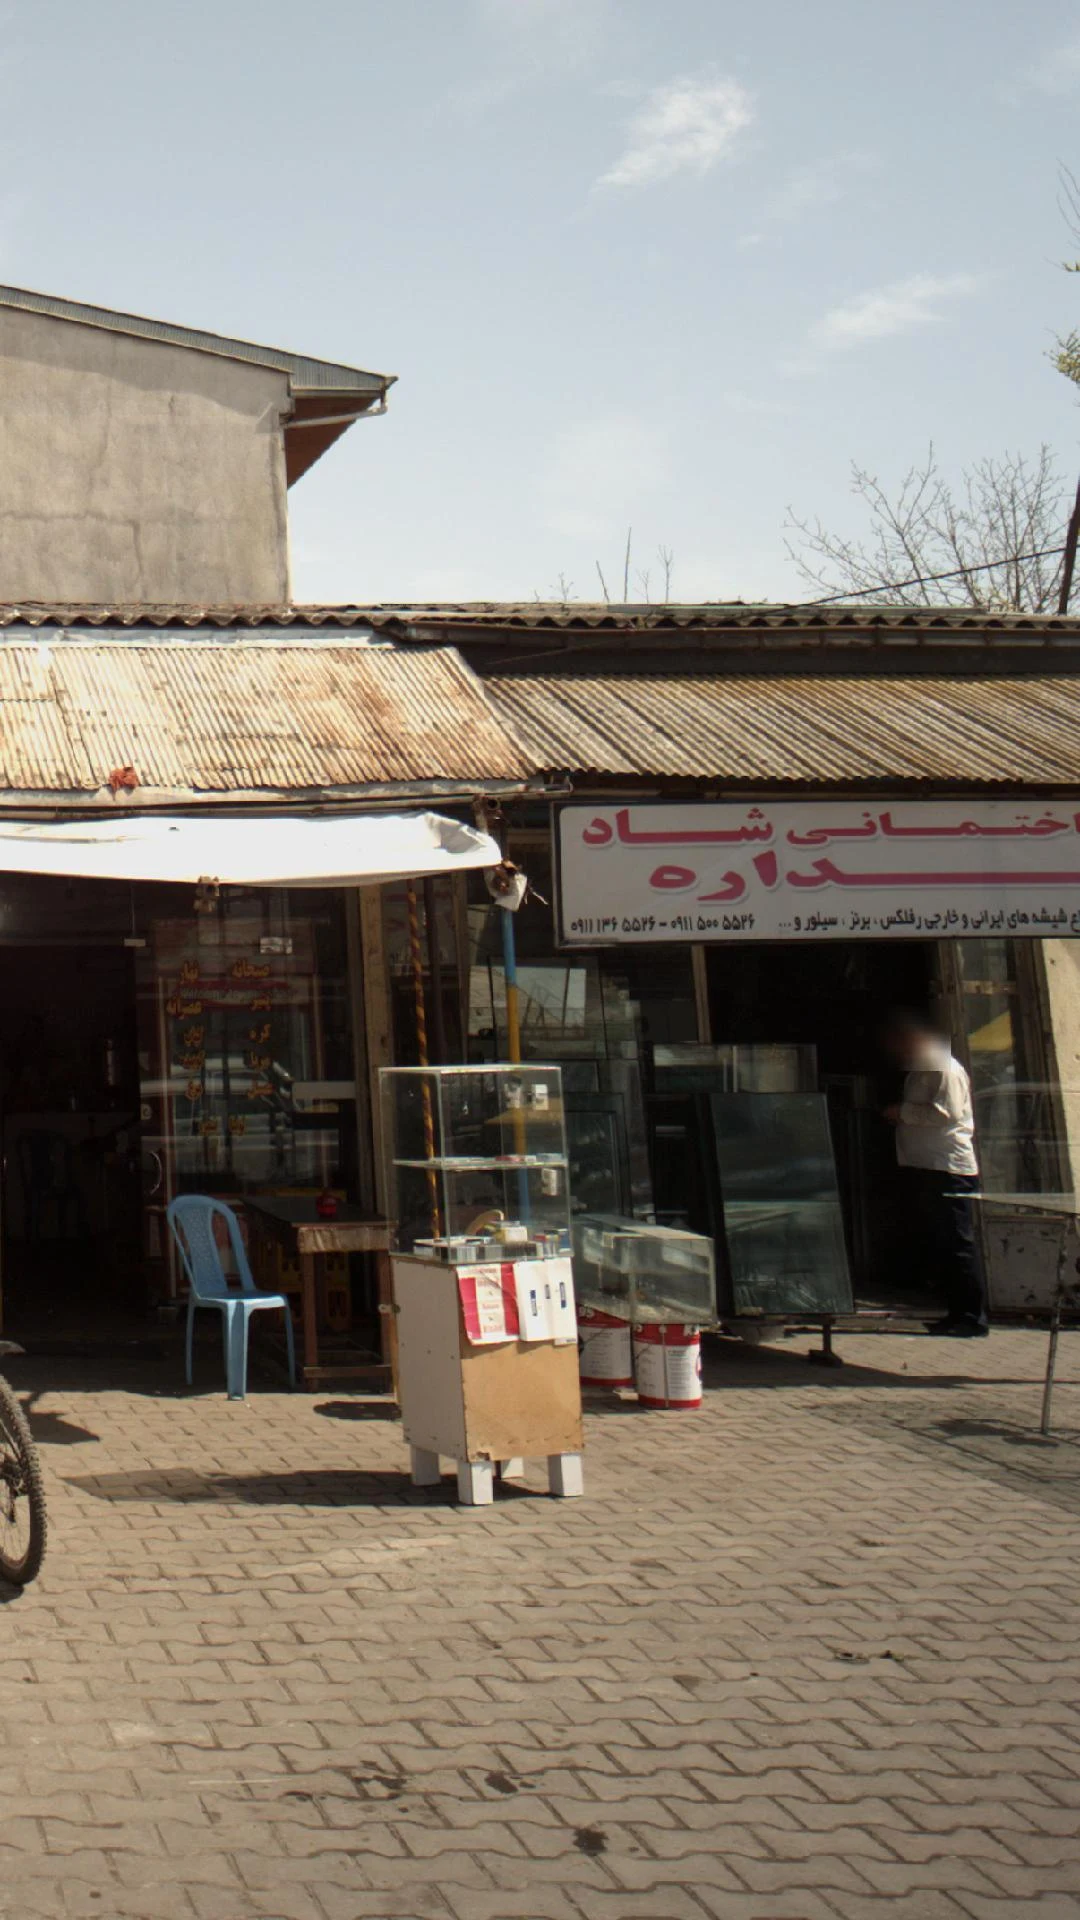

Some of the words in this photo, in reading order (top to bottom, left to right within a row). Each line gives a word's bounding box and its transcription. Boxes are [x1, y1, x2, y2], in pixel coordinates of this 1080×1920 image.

[583, 808, 773, 845] شاد
[649, 849, 1080, 901] داره
[571, 917, 593, 933] ۰۹۱۱
[597, 916, 618, 932] ۱۳۶
[622, 915, 656, 932] ۵۵۲۶
[671, 915, 693, 932] ۰۹۱۱
[697, 915, 719, 931] ۵۰۰
[722, 912, 755, 931] ۵۵۲۶
[804, 911, 838, 931] سیلور
[924, 908, 959, 929] خارجی
[962, 913, 969, 929] و
[971, 909, 1005, 929] ایرانی
[1007, 908, 1030, 929] های
[1032, 906, 1068, 928] شیشه
